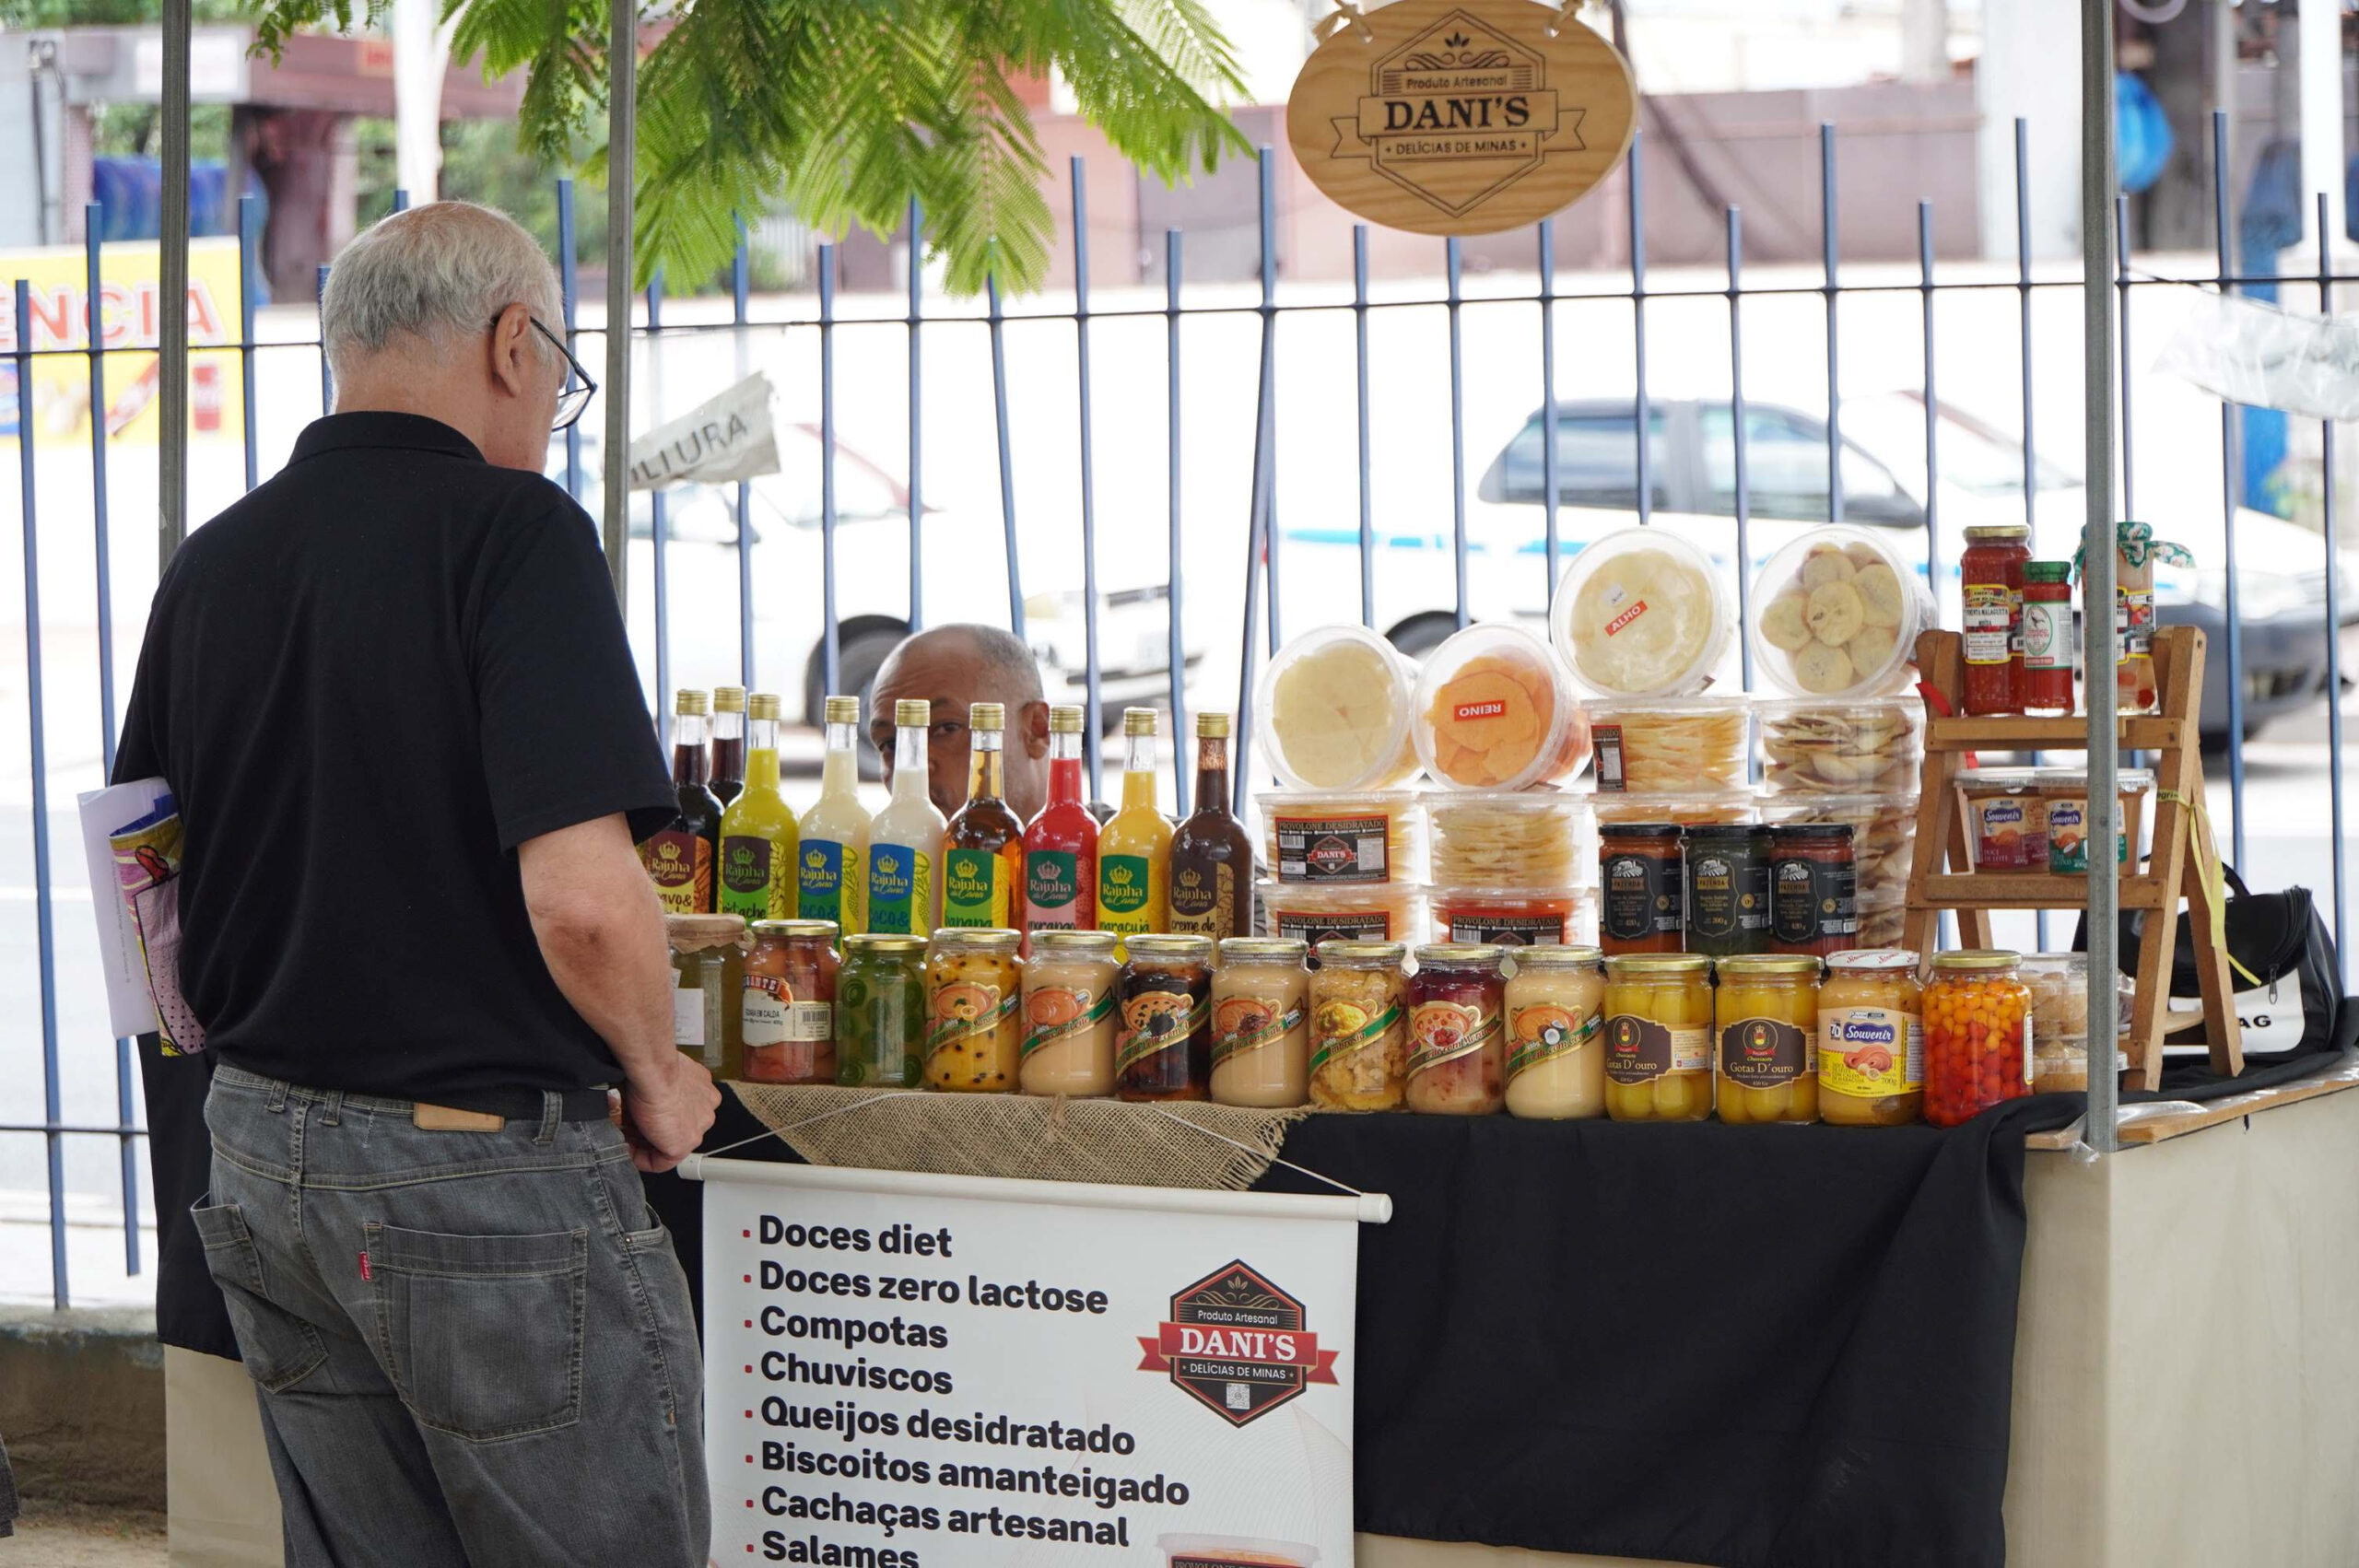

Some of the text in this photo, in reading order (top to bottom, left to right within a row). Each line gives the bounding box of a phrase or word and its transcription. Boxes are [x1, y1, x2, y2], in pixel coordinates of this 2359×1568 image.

[1407, 73, 1508, 90] Produto Artesanal
[1383, 96, 1531, 132] DANI'S
[1396, 139, 1516, 156] DELÍCIAS DE MINAS
[1611, 605, 1641, 632] ALHO
[1459, 703, 1502, 718] REINO
[1985, 810, 2020, 822] Souvenir
[1325, 819, 1385, 830] DESIDRATADO
[1317, 850, 1346, 859] DANI'S
[651, 858, 690, 873] Rainha
[725, 863, 765, 878] Rainha
[800, 867, 837, 881] Rainha
[871, 872, 908, 886] Rainha
[948, 876, 988, 891] Rainha
[1029, 879, 1072, 893] Rainha
[1103, 883, 1143, 897] Rainha
[1172, 886, 1212, 900] Rainha
[1202, 916, 1216, 933] de
[1327, 916, 1386, 925] DESIDRATADO
[1453, 916, 1501, 926] PROVOLONE
[2237, 1014, 2271, 1029] AG
[1846, 1024, 1892, 1042] Souvenir
[1442, 1041, 1461, 1054] com
[1548, 1042, 1568, 1054] com
[1730, 1061, 1755, 1073] Gotas
[1881, 1077, 1897, 1086] 700g
[760, 1214, 953, 1258] Doces diet
[760, 1259, 1109, 1315] Doces zero lactose
[1198, 1309, 1278, 1325] Produto Artesanal
[760, 1305, 948, 1350] Compotas
[1180, 1328, 1297, 1362] DANI'S
[760, 1351, 953, 1395] Chuviscos
[1190, 1361, 1286, 1380] DELÍCIAS DE MINAS
[760, 1395, 1135, 1456] Queijos desidratado
[762, 1440, 1190, 1509] Biscoitos amanteigado
[761, 1485, 1130, 1548] Cachaças artesanal
[762, 1530, 920, 1568] Salames
